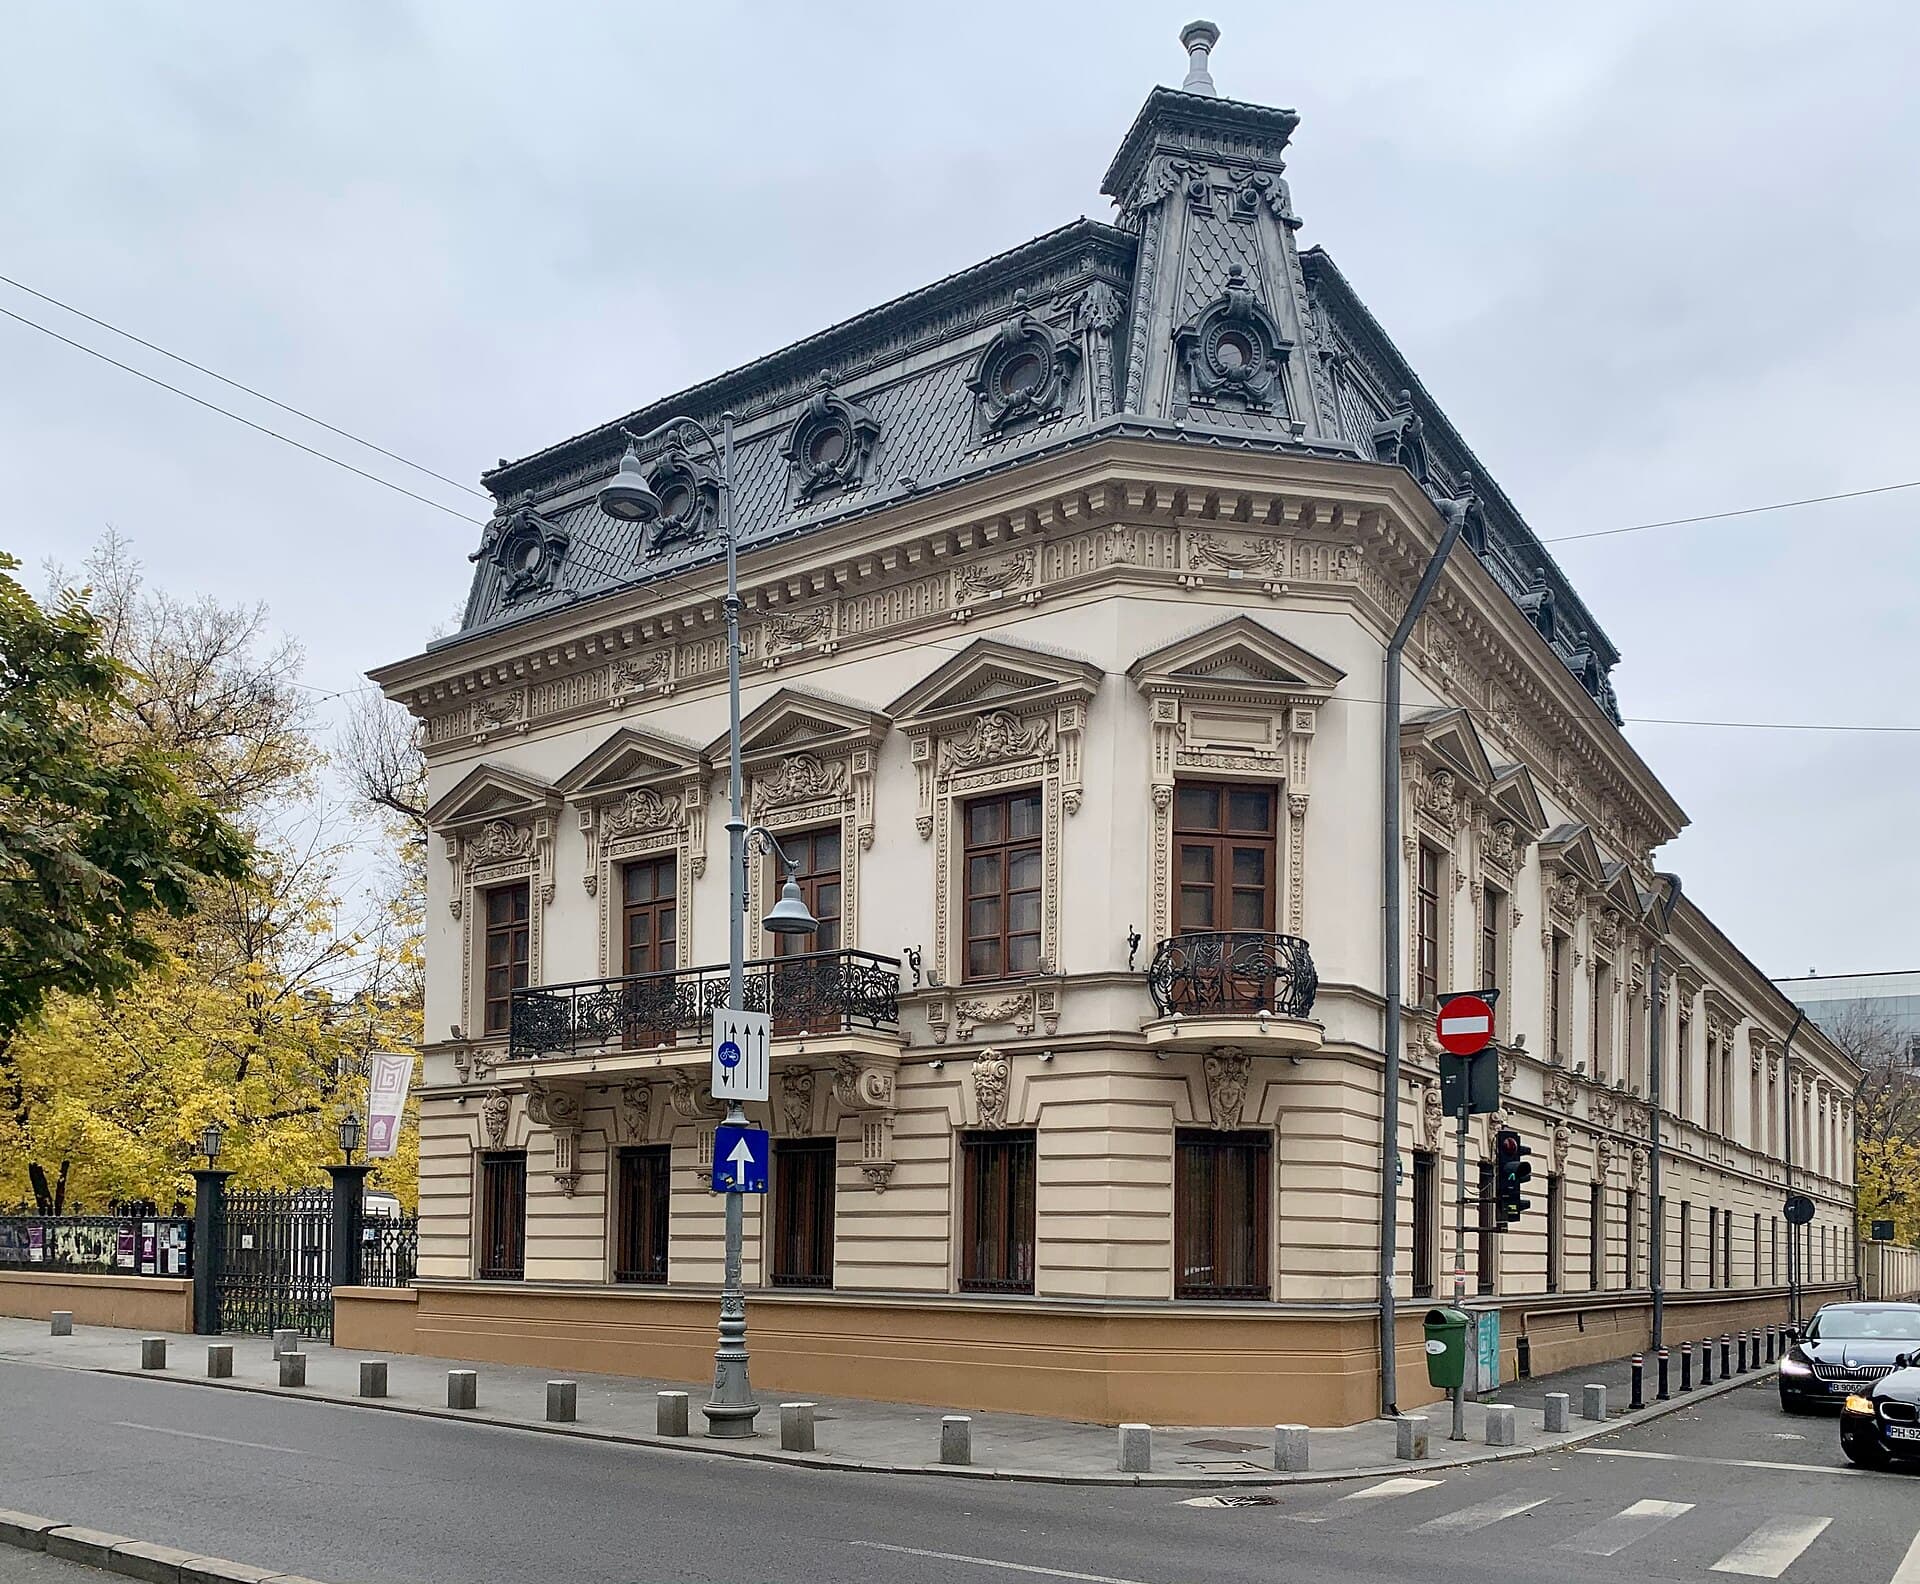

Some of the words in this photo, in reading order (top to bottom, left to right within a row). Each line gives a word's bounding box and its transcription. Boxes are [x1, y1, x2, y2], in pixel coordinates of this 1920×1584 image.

[1833, 1383, 1839, 1391] B
[1891, 1427, 1905, 1438] PH
[1909, 1429, 1920, 1439] 92
